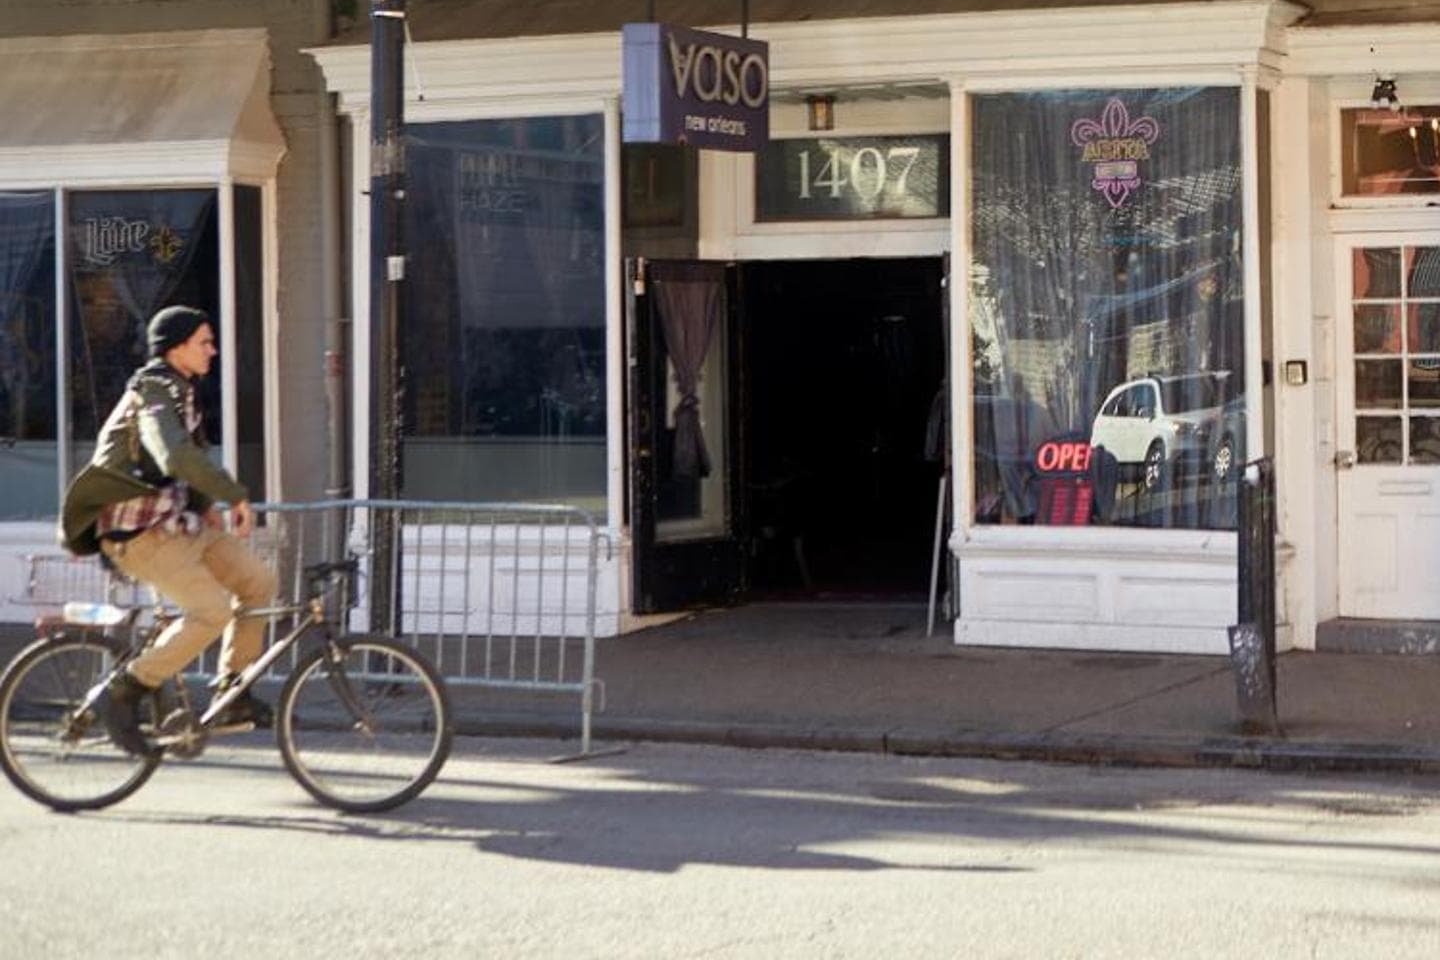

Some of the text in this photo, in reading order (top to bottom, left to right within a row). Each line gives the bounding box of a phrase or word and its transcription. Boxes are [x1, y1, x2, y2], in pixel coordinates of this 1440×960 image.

[668, 32, 767, 108] vaso
[685, 114, 746, 137] new orleans
[799, 146, 920, 200] 1407
